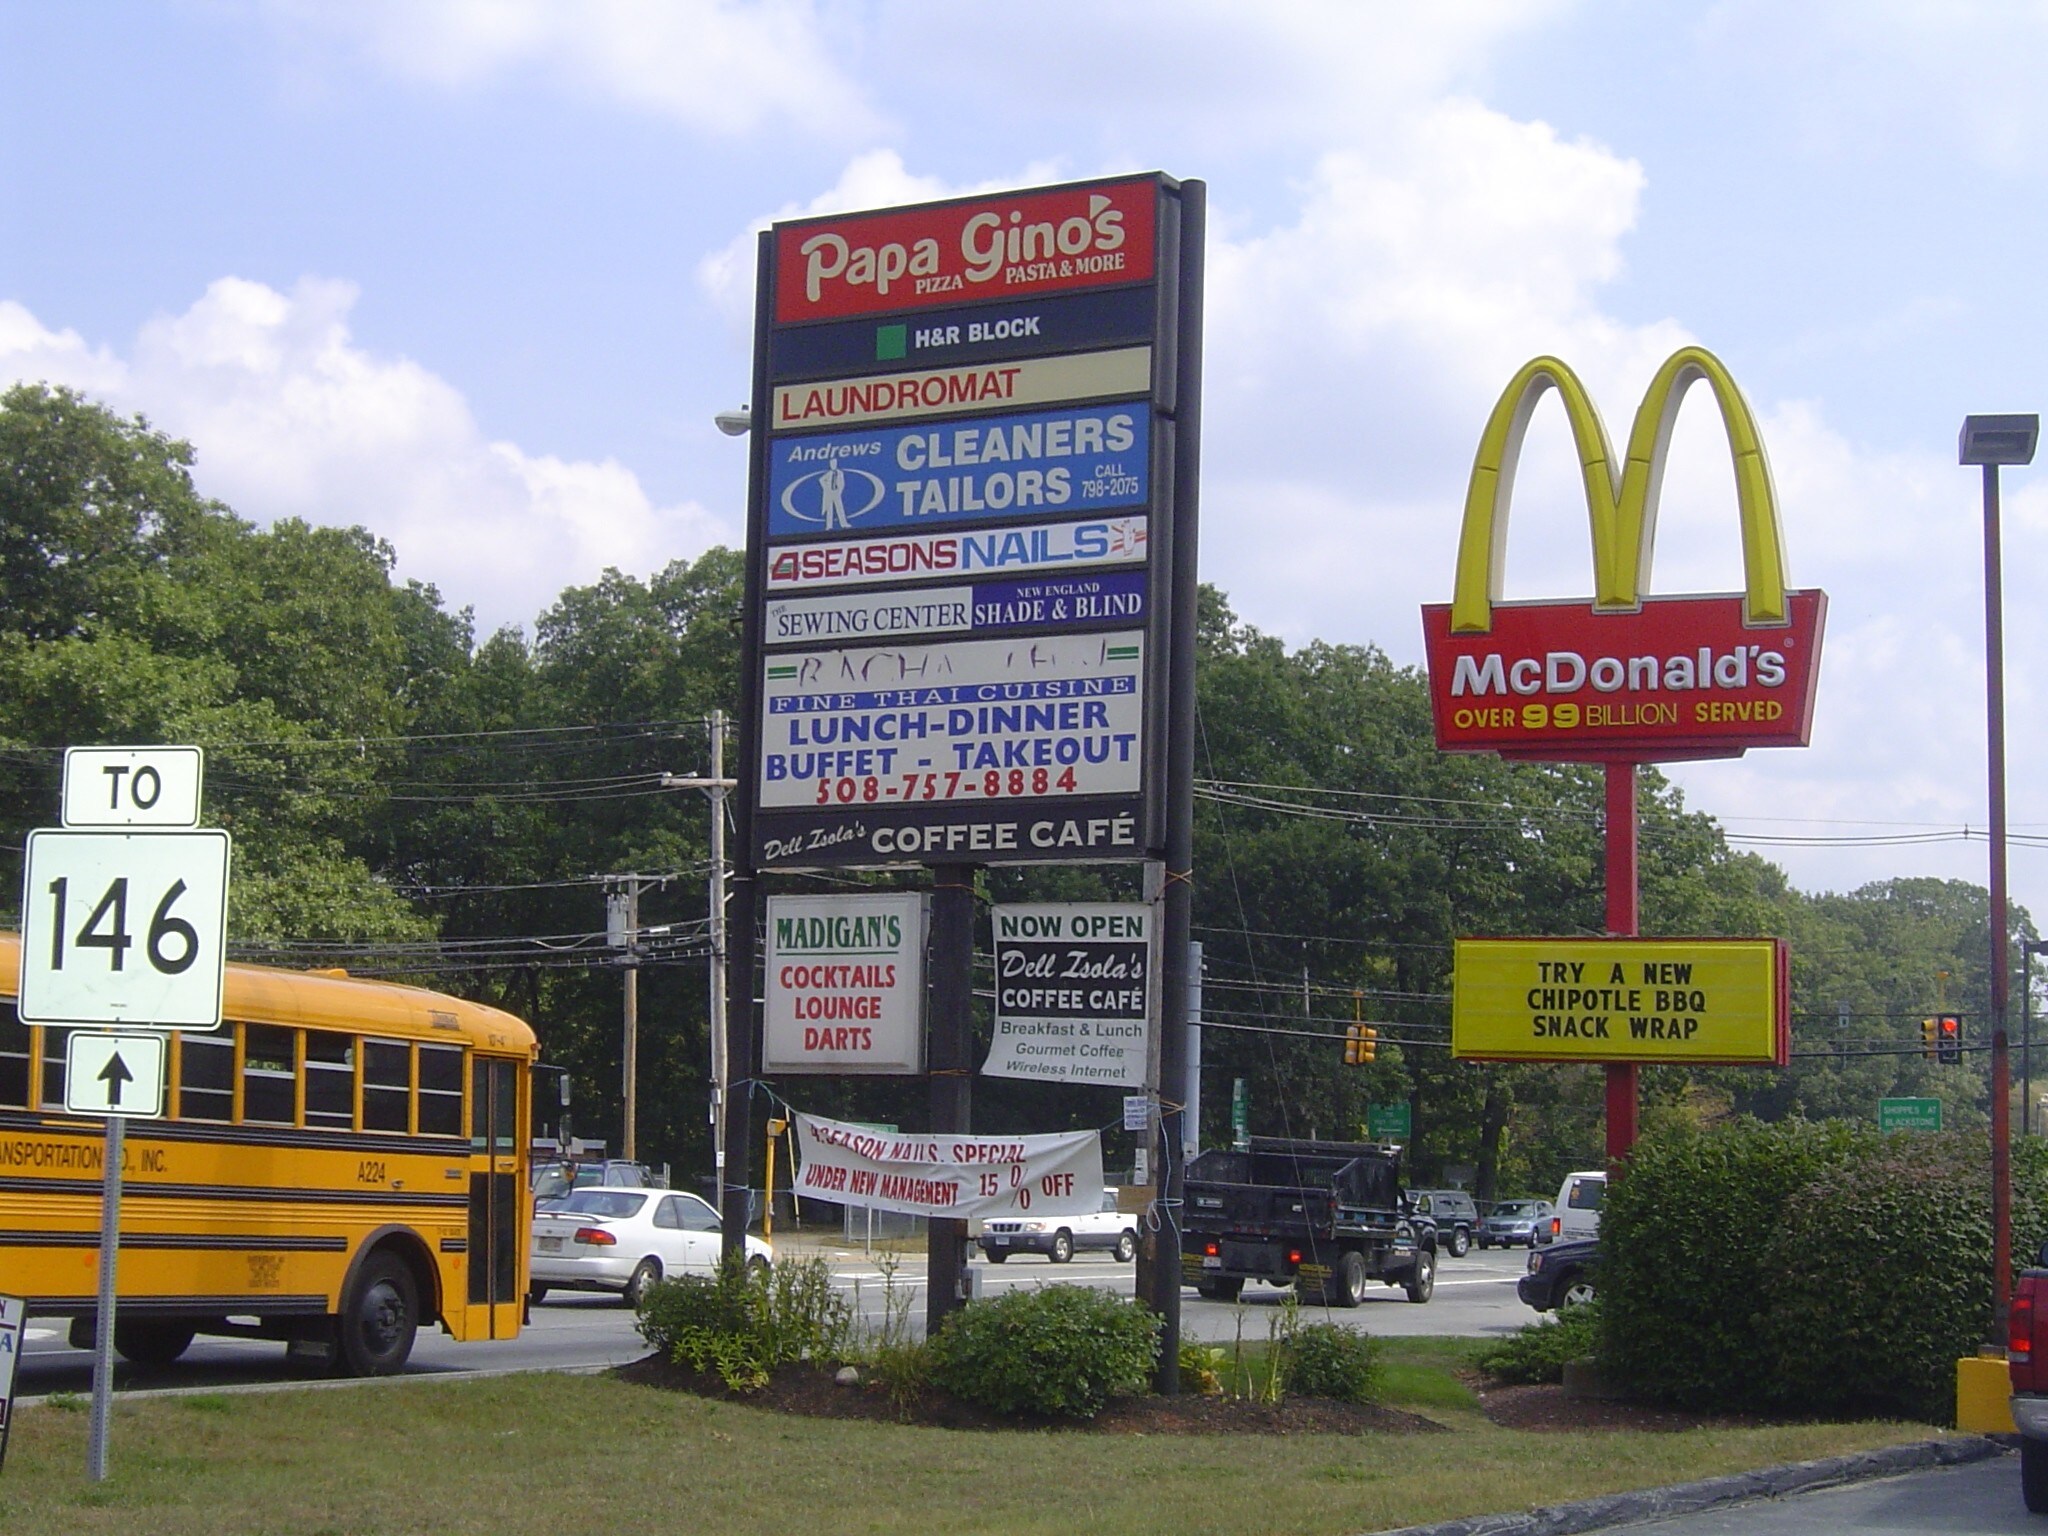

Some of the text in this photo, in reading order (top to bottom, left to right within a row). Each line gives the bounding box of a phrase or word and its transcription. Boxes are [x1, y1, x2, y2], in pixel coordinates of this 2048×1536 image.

[801, 195, 1125, 302] Papa Gino's
[915, 252, 1125, 295] PIZZA PASTA & MORE
[915, 317, 1040, 349] H&R BLOCK
[781, 368, 1021, 421] LAUNDROMAT
[788, 414, 1135, 471] Andrews CLEANERS
[1081, 477, 1139, 498] 798-2075
[1095, 464, 1126, 479] CALL
[896, 467, 1072, 517] TAILORS
[962, 524, 1109, 570] NAILS
[1016, 582, 1100, 597] NEW ENGLAND
[778, 603, 968, 637] SEWING CENTER
[974, 593, 1142, 626] SHADE & BLIND
[1451, 645, 1786, 696] McDonald's
[775, 677, 1130, 712] FINE THAI CUISINE
[789, 700, 1110, 747] LUNCH-DINNER
[1454, 700, 1782, 729] OVER 99 BILLION SERVED
[766, 746, 898, 781] BUFFET
[952, 733, 1136, 770] TAKEOUT
[103, 766, 161, 810] TO
[815, 766, 1078, 804] 508-757-8884
[763, 812, 1135, 860] Dell Isola's COFFEE CAFÉ
[48, 877, 199, 974] 146
[776, 914, 901, 951] MADIGAN'S
[1000, 915, 1144, 938] NOW OPEN
[780, 964, 896, 990] COCKTAILS
[1002, 950, 1144, 981] Dell Isola's
[1538, 961, 1692, 985] TRY A NEW
[795, 996, 881, 1020] LOUNGE
[1002, 986, 1143, 1011] COFFEE CAFÉ
[1527, 989, 1706, 1014] CHIPOTLE BBQ
[804, 1027, 872, 1051] DARTS
[1000, 1020, 1142, 1037] Breakfast & Lunch
[1533, 1015, 1699, 1040] SNACK WRAP
[1015, 1042, 1124, 1058] Gourmet Coffee
[1005, 1060, 1127, 1078] Wireless Internet
[141, 1149, 167, 1172] INC.
[357, 1161, 385, 1183] A224
[805, 1164, 846, 1188] UNDER
[850, 1169, 878, 1195] NEW
[880, 1174, 958, 1207] MANAGEMENT
[979, 1173, 998, 1197] 15
[1042, 1173, 1075, 1197] OFF
